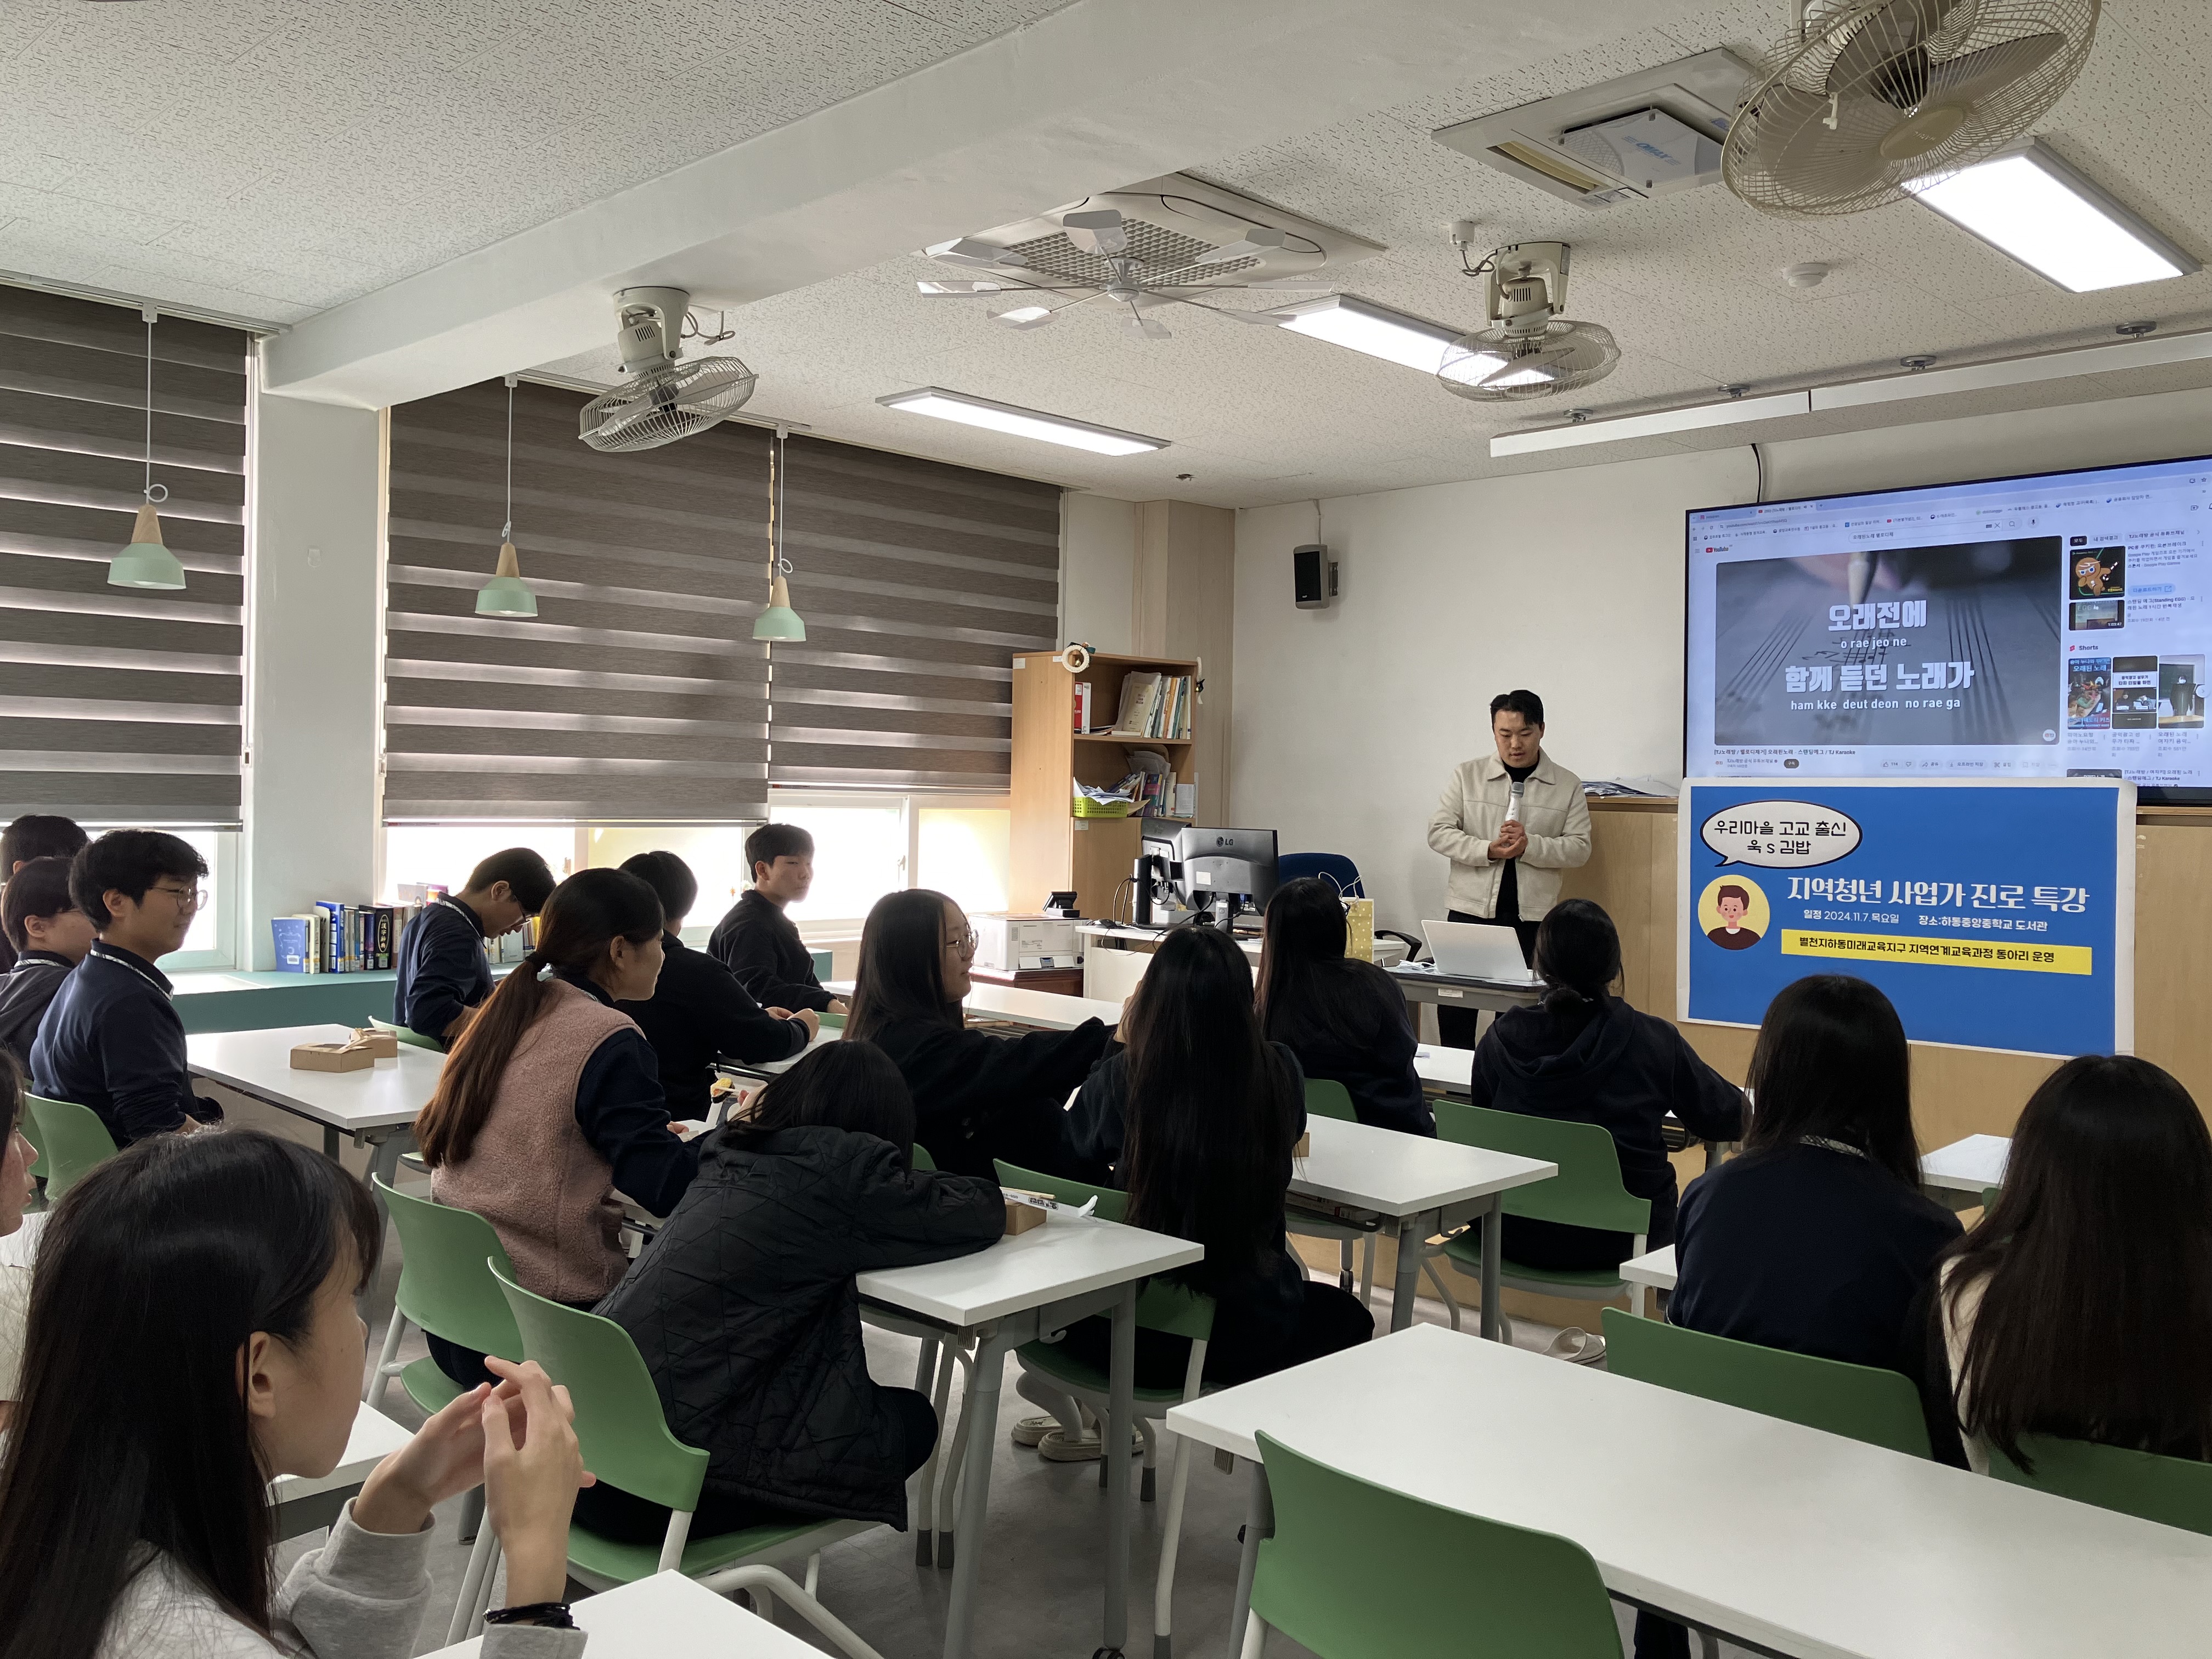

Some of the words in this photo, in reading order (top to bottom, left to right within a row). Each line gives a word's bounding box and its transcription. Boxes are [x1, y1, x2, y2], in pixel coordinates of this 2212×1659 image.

[1828, 600, 1927, 631] 오래전에
[1841, 640, 1848, 649] o
[1850, 639, 1870, 648] rae
[1871, 636, 1889, 650] jeo
[1893, 637, 1908, 647] ne
[1785, 665, 1833, 693] 함께
[1839, 664, 1888, 692] 듣던
[1896, 661, 1976, 691] 노래가
[1791, 699, 1814, 710] ham
[1817, 699, 1837, 710] kke
[1843, 698, 1869, 710] deut
[1871, 698, 1899, 709] deon
[1905, 700, 1920, 709] no
[1922, 699, 1943, 709] rae
[1946, 699, 1961, 710] ga
[1714, 820, 1774, 835] 우리마을
[1779, 821, 1810, 836] 고교
[1815, 821, 1847, 836] 출신
[1747, 839, 1762, 854] 욱
[1780, 840, 1812, 855] 김밥
[1787, 877, 1882, 904] 지역청년
[1888, 880, 1967, 907] 사업가
[1970, 883, 2027, 909] 진로
[2030, 886, 2091, 913] 특강
[1803, 909, 1822, 920] 일정
[1824, 911, 1900, 924] 2024.11.7.목요일
[1918, 915, 2013, 930] 장소:하동중앙중학교
[2015, 919, 2048, 933] 도서관
[1799, 936, 1906, 953] 별천지하동미래교육지구
[1909, 944, 1994, 959] 지역연계교육과정
[1996, 949, 2029, 961] 동아리
[2032, 951, 2055, 963] 운영
